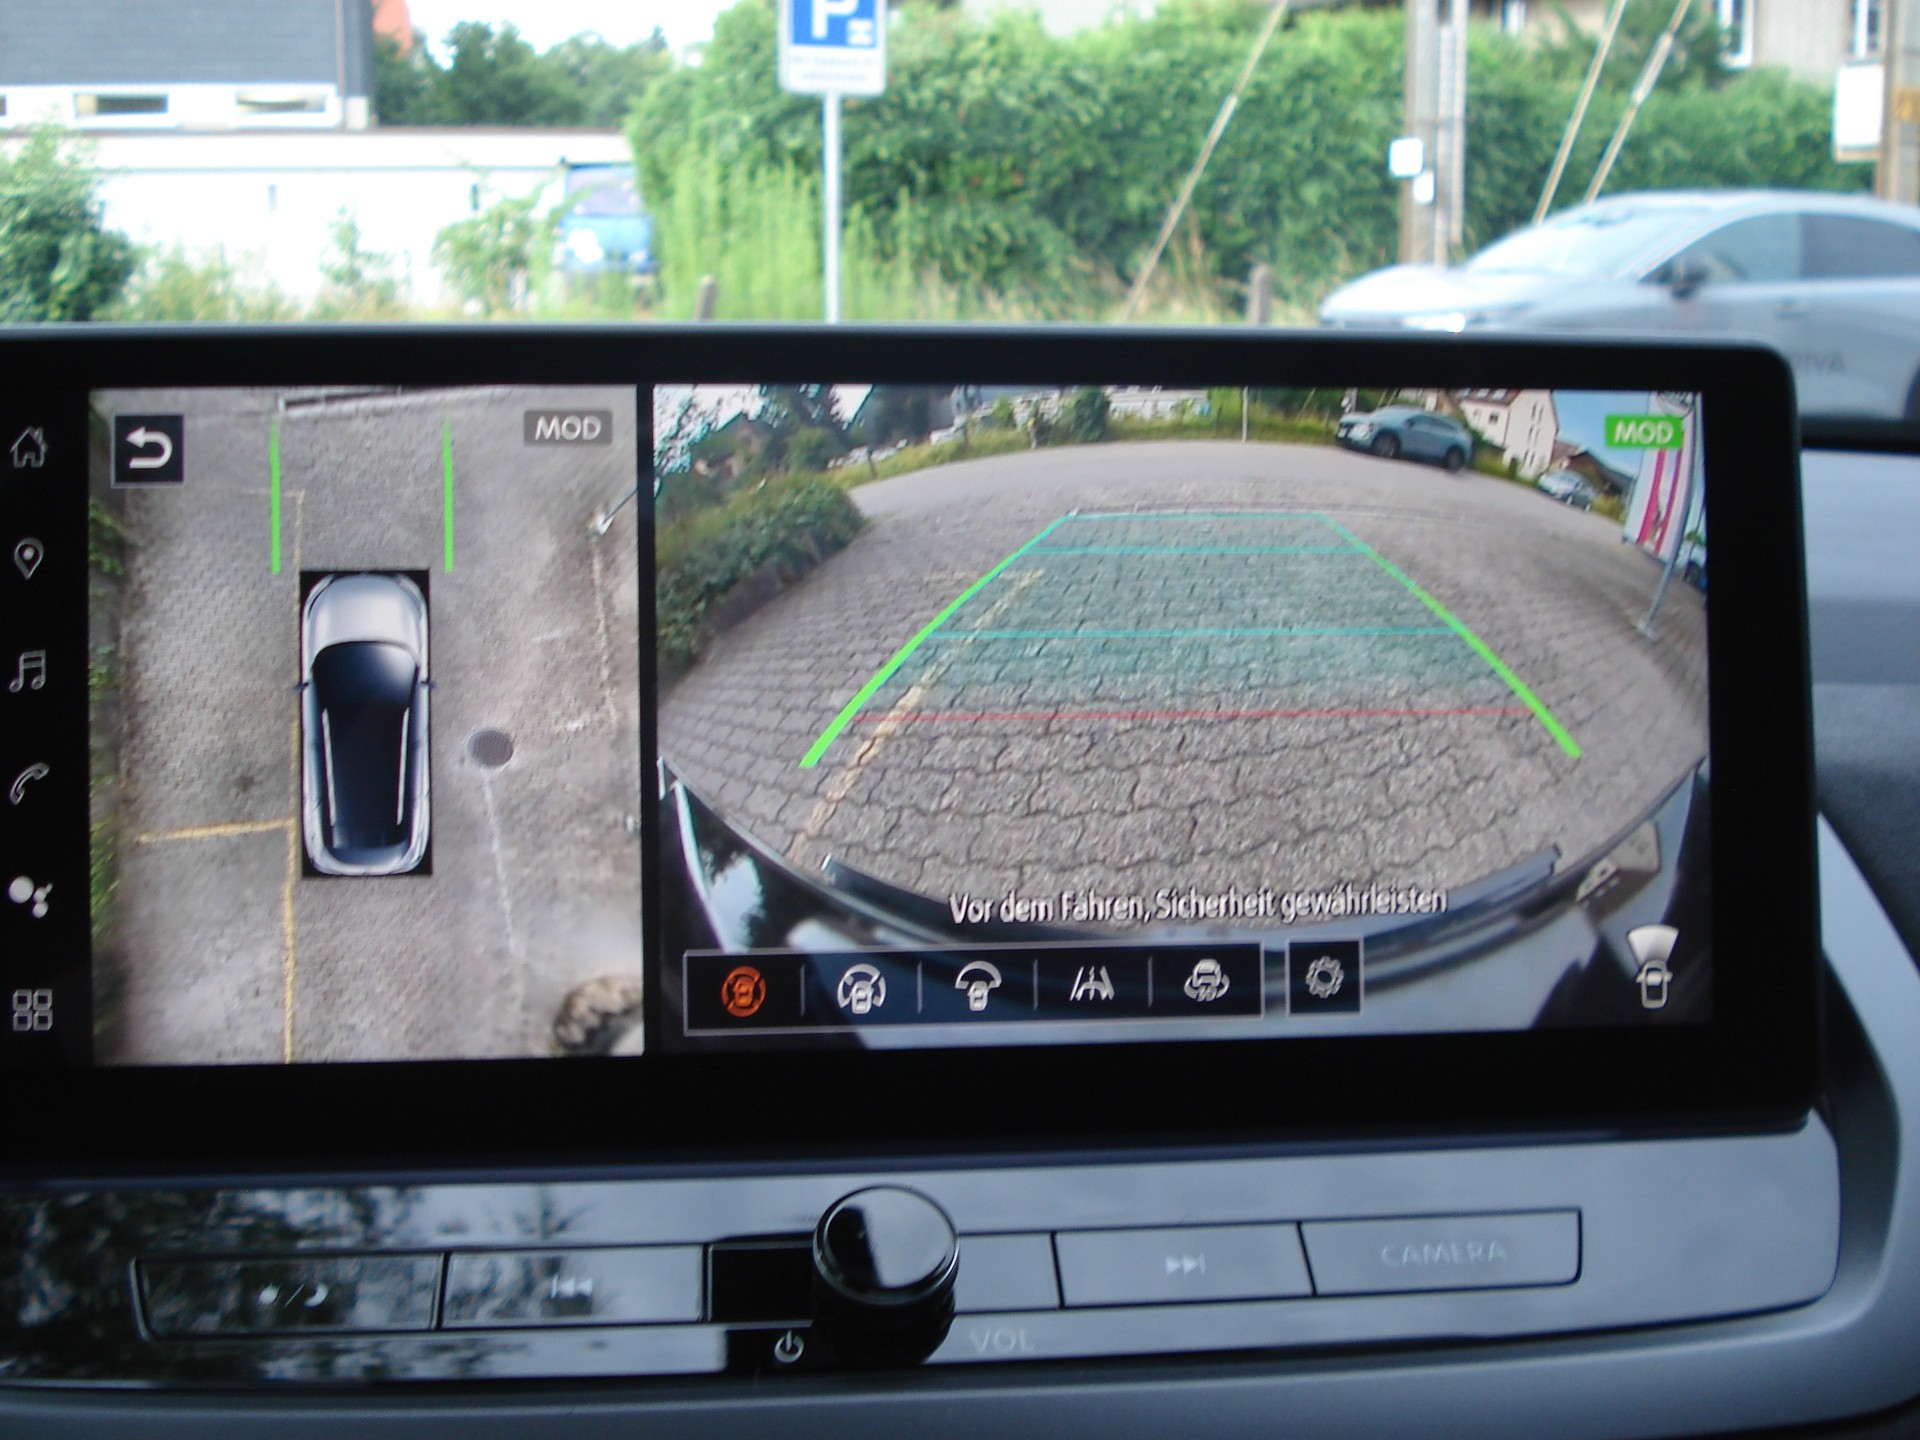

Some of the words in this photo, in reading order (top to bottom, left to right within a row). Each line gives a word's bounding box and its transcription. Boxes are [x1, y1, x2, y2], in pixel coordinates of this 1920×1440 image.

[811, 0, 858, 37] P
[535, 415, 602, 441] MOD
[1615, 420, 1674, 445] MOD
[949, 892, 994, 924] Vor
[1000, 890, 1053, 923] dem
[1155, 886, 1275, 920] Sicherheit
[1281, 882, 1448, 924] gewährleisten
[1380, 1240, 1508, 1268] CAMERA
[969, 1327, 1036, 1354] VOL
